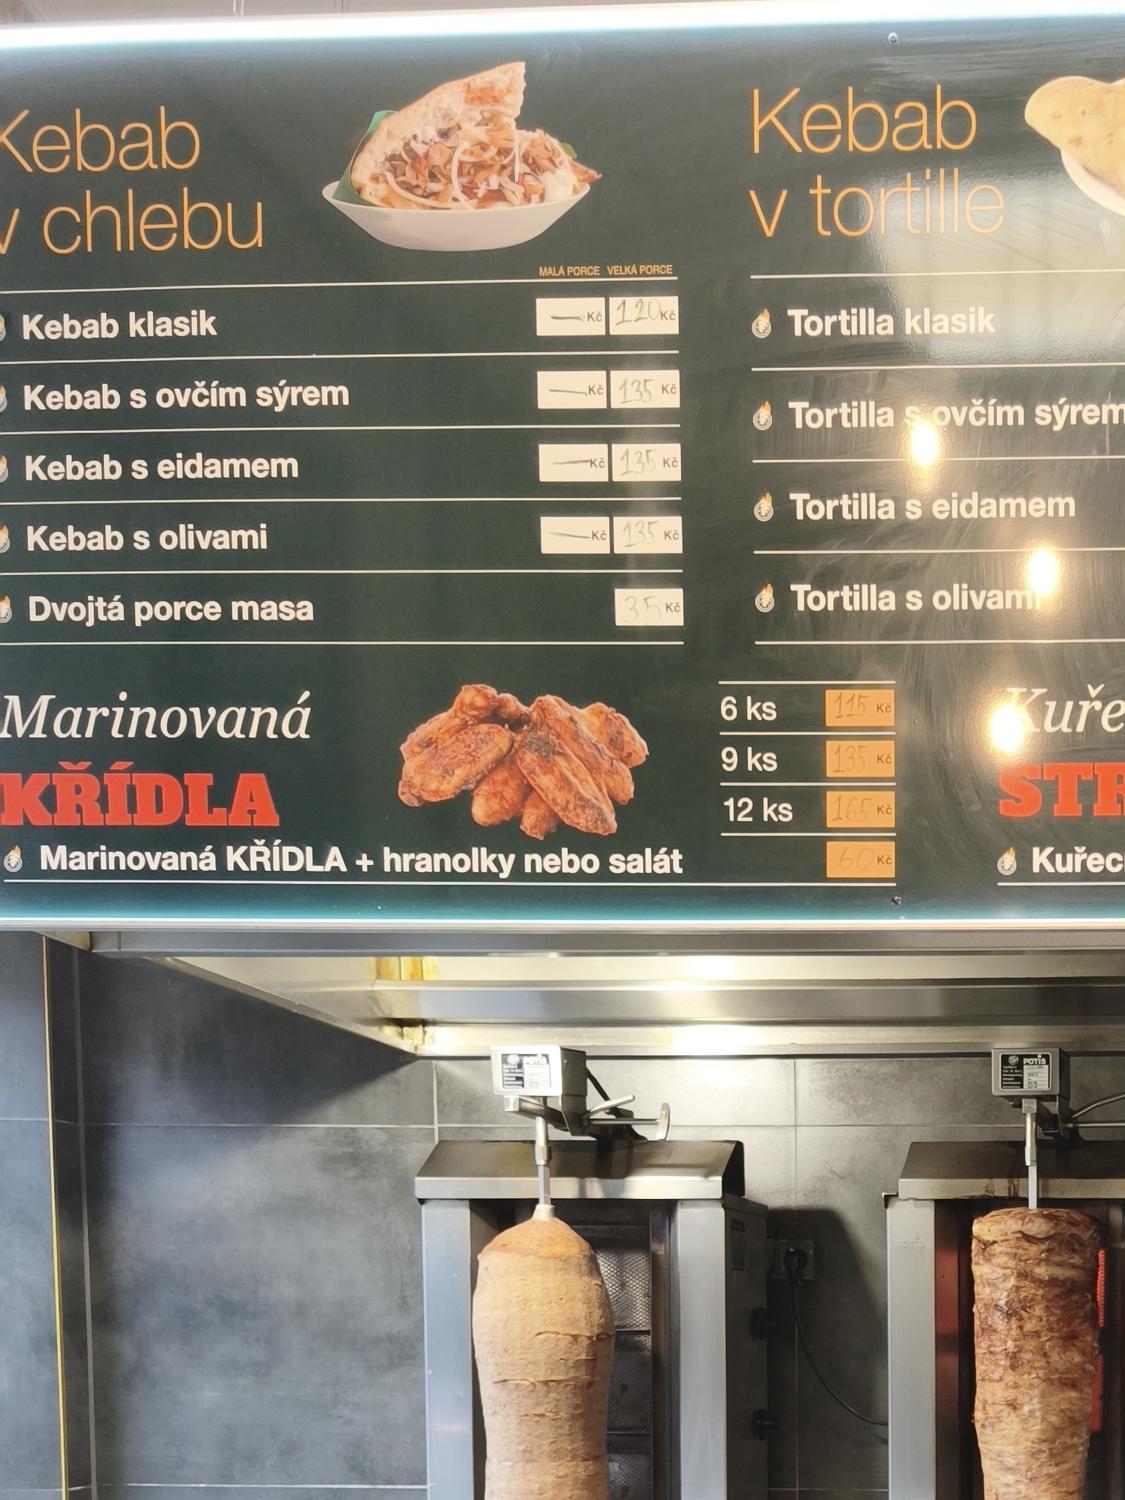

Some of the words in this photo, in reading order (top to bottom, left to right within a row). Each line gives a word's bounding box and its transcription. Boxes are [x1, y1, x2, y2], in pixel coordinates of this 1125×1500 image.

[752, 86, 976, 154] Kebab
[748, 191, 788, 238] v
[809, 169, 1003, 238] tortille
[42, 188, 263, 255] chlebu
[539, 265, 565, 278] MALÁ
[566, 265, 600, 277] PORCE
[606, 264, 638, 275] VELKÁ
[639, 264, 673, 275] PORCE
[23, 313, 119, 339] Kebab
[130, 310, 217, 337] klasik
[586, 311, 603, 322] Kč
[616, 298, 662, 326] 120
[661, 310, 676, 321] Kč
[788, 308, 894, 336] Tortilla
[905, 307, 996, 336] klasik
[24, 384, 120, 410] Kebab
[130, 389, 146, 408] s
[156, 381, 246, 408] ovčím
[257, 380, 349, 412] sýrem
[588, 383, 604, 395] Kč
[619, 377, 656, 404] 135
[661, 383, 677, 395] Kč
[789, 401, 894, 428] Tortilla
[904, 404, 921, 427] s
[932, 398, 1024, 427] ovčím
[26, 454, 122, 480] Kebab
[132, 460, 148, 479] s
[158, 453, 298, 479] eidamem
[590, 457, 606, 469] Kč
[620, 448, 657, 476] 135
[662, 456, 679, 468] Kč
[790, 493, 894, 520] Tortilla
[906, 499, 923, 519] s
[934, 491, 1076, 520] eidamem
[27, 525, 123, 551] Kebab
[133, 531, 150, 550] s
[160, 524, 267, 549] olivami
[592, 530, 608, 541] Kč
[622, 519, 659, 548] 135
[663, 529, 680, 541] Kč
[29, 595, 124, 626] Dvojtá
[135, 601, 221, 626] porce
[232, 601, 313, 620] masa
[623, 594, 662, 624] 35
[665, 601, 681, 613] Kč
[791, 584, 895, 611] Tortilla
[906, 590, 922, 610] s
[0, 691, 311, 738] Marinovaná
[721, 696, 737, 720] 6
[747, 696, 776, 720] ks
[876, 702, 892, 714] Kč
[722, 747, 737, 771] 9
[748, 747, 777, 771] ks
[832, 743, 868, 773] 135
[876, 753, 892, 765] Kč
[0, 762, 278, 826] KŘÍDLA
[724, 798, 753, 821] 12
[763, 798, 792, 821] ks
[831, 793, 872, 824] 165
[877, 804, 892, 815] Kč
[41, 845, 216, 871] Marinovaná
[227, 839, 347, 871] KŘÍDLA
[356, 854, 373, 872] +
[384, 847, 515, 878] hranolky
[525, 848, 599, 873] nebo
[609, 848, 683, 873] salát
[837, 845, 876, 871] 60
[877, 853, 893, 865] Kč
